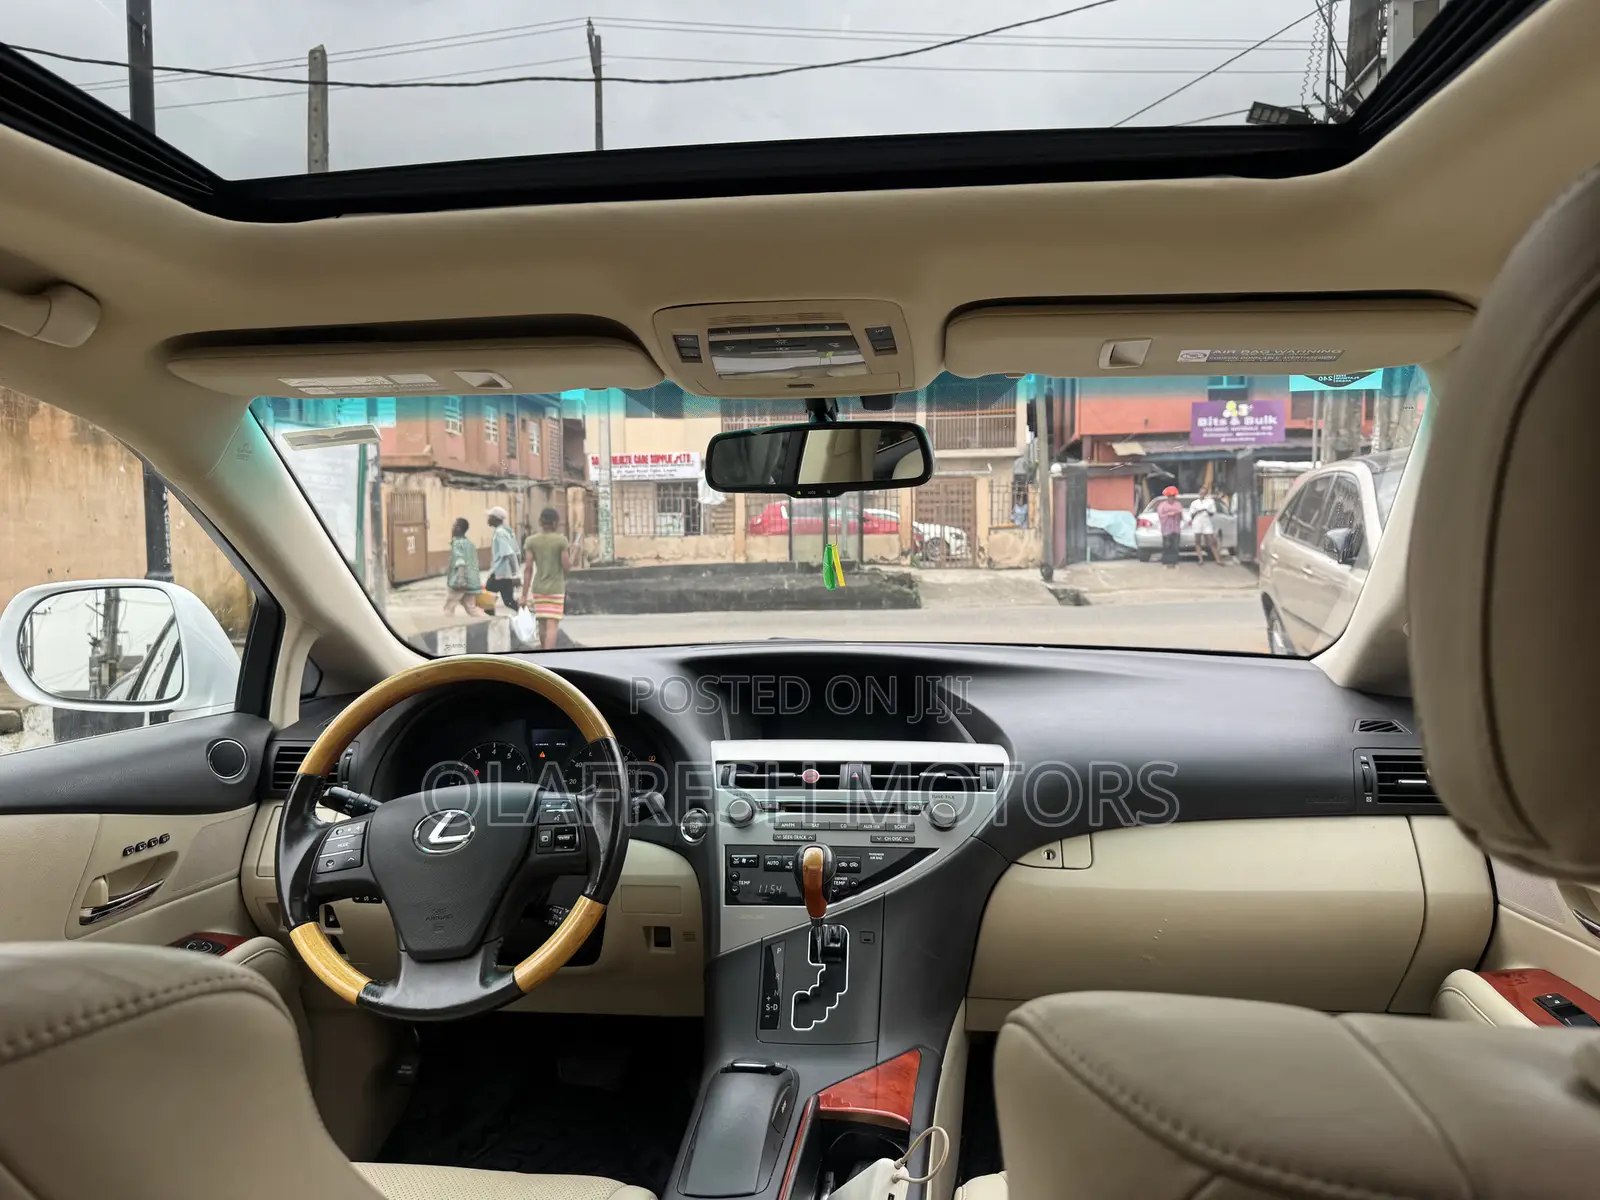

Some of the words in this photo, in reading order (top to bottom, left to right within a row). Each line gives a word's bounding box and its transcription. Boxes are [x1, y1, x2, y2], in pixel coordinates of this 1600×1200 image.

[1197, 416, 1227, 427] Bits
[1229, 416, 1240, 426] &
[1244, 415, 1278, 425] Bulk
